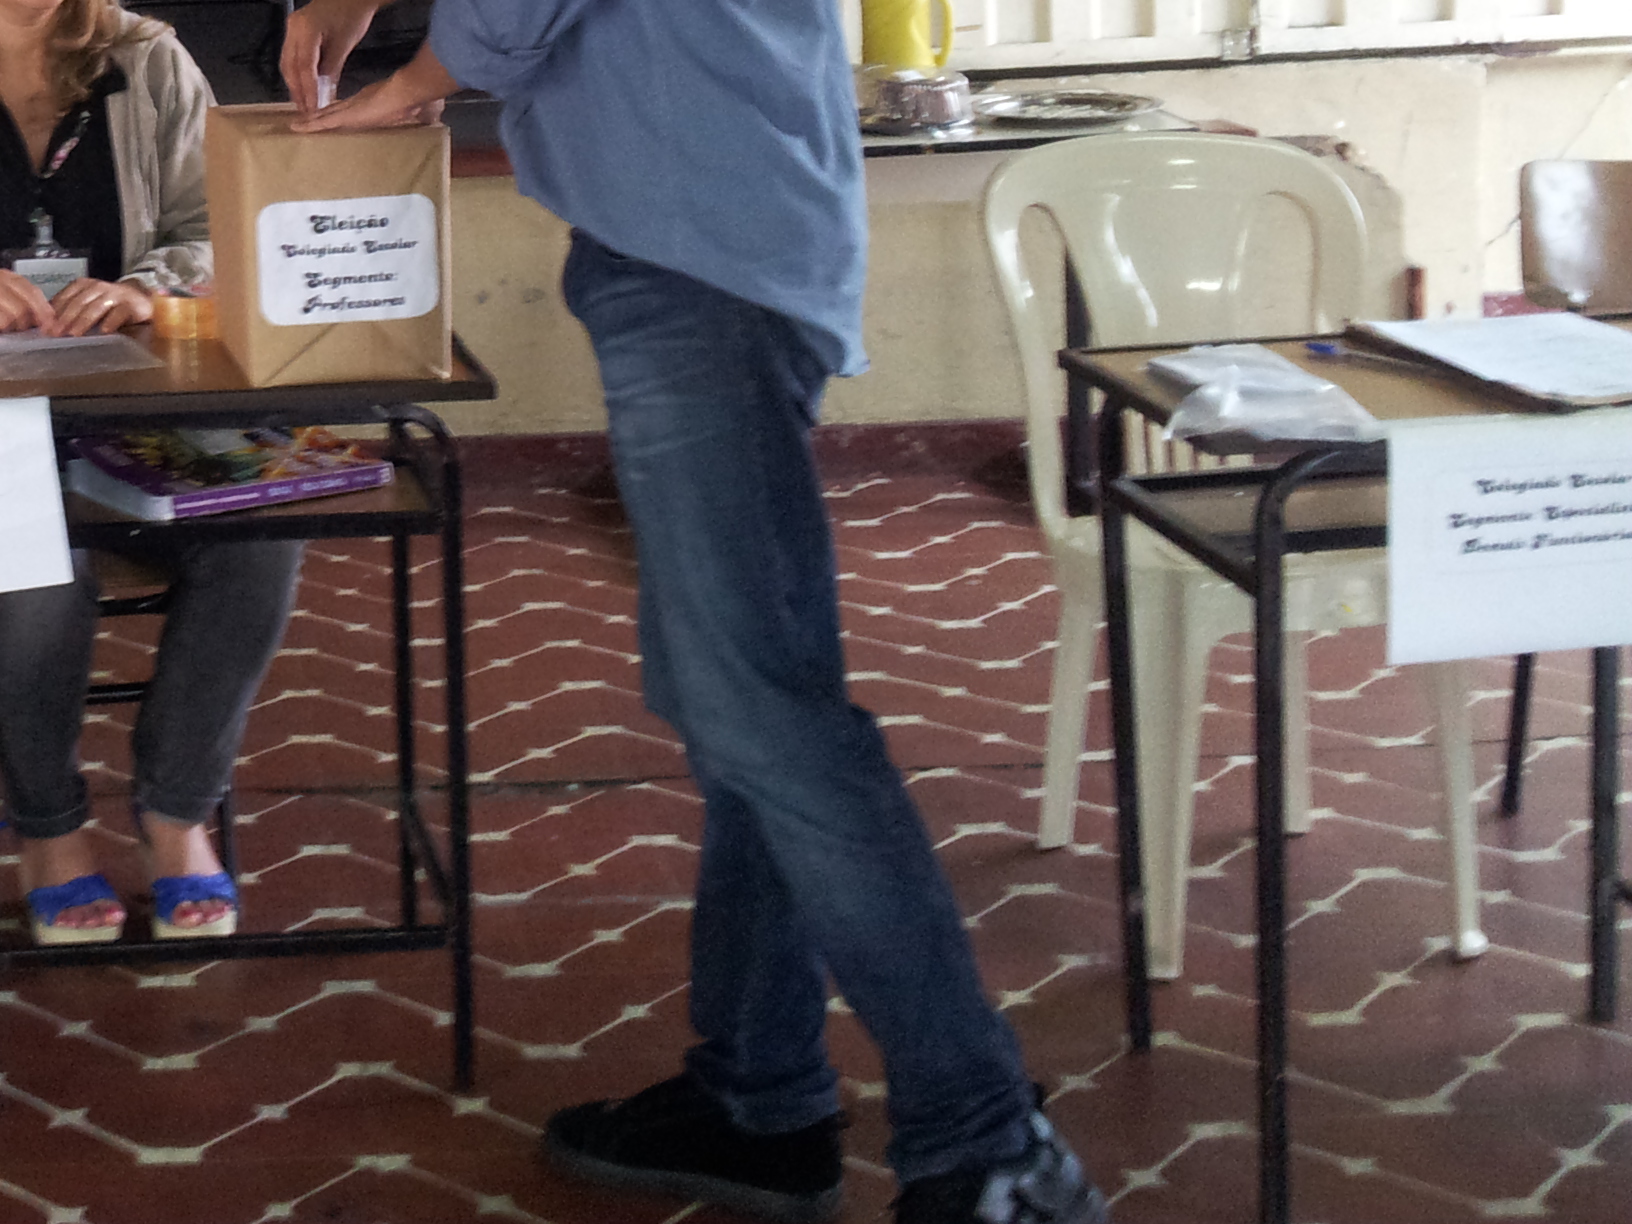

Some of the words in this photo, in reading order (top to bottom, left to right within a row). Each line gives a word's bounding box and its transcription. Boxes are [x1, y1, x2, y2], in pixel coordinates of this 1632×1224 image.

[309, 214, 389, 234] Eleição
[281, 243, 357, 259] Colegiado
[363, 237, 418, 254] Escolar
[303, 294, 406, 314] Professores
